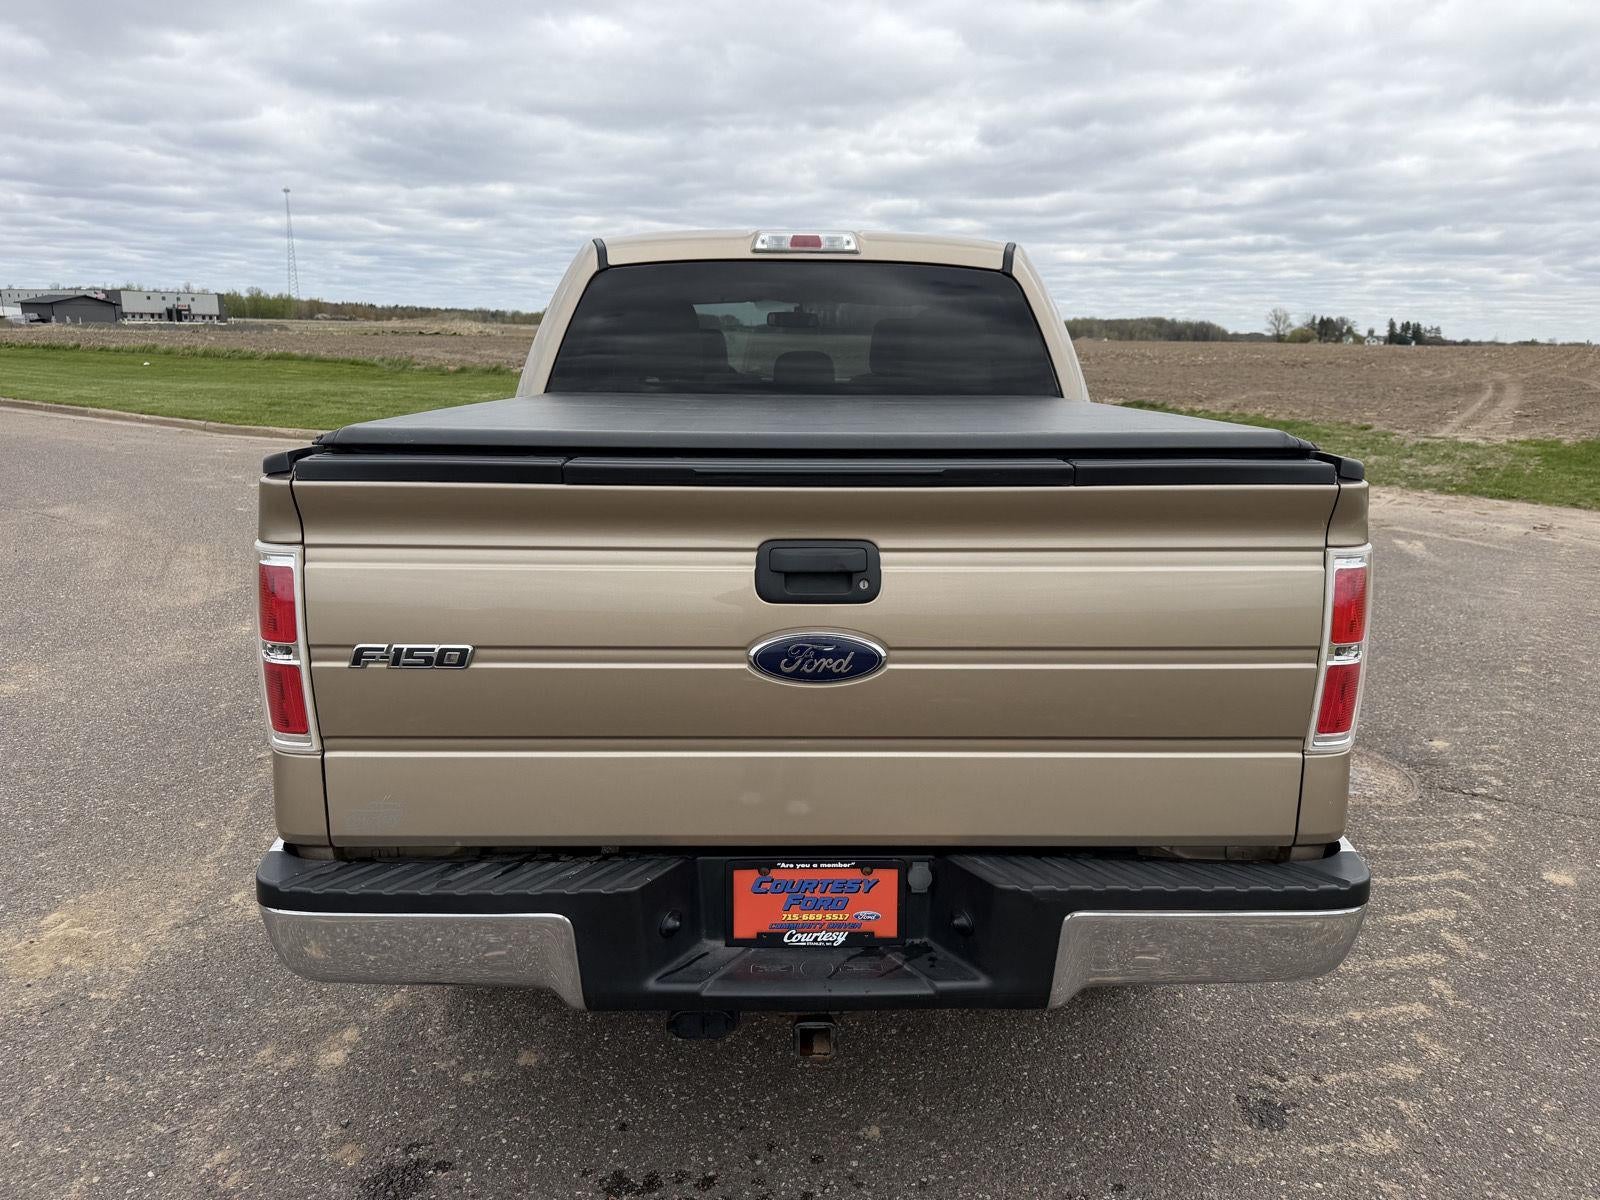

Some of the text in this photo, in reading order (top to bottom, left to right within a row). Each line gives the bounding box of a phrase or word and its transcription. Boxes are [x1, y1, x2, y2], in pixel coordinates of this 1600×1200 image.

[349, 643, 474, 669] F-150
[780, 643, 855, 673] Ford
[781, 913, 850, 921] 715-669-5517
[769, 922, 824, 930] COMMUNITY
[783, 930, 849, 946] Courtesy
